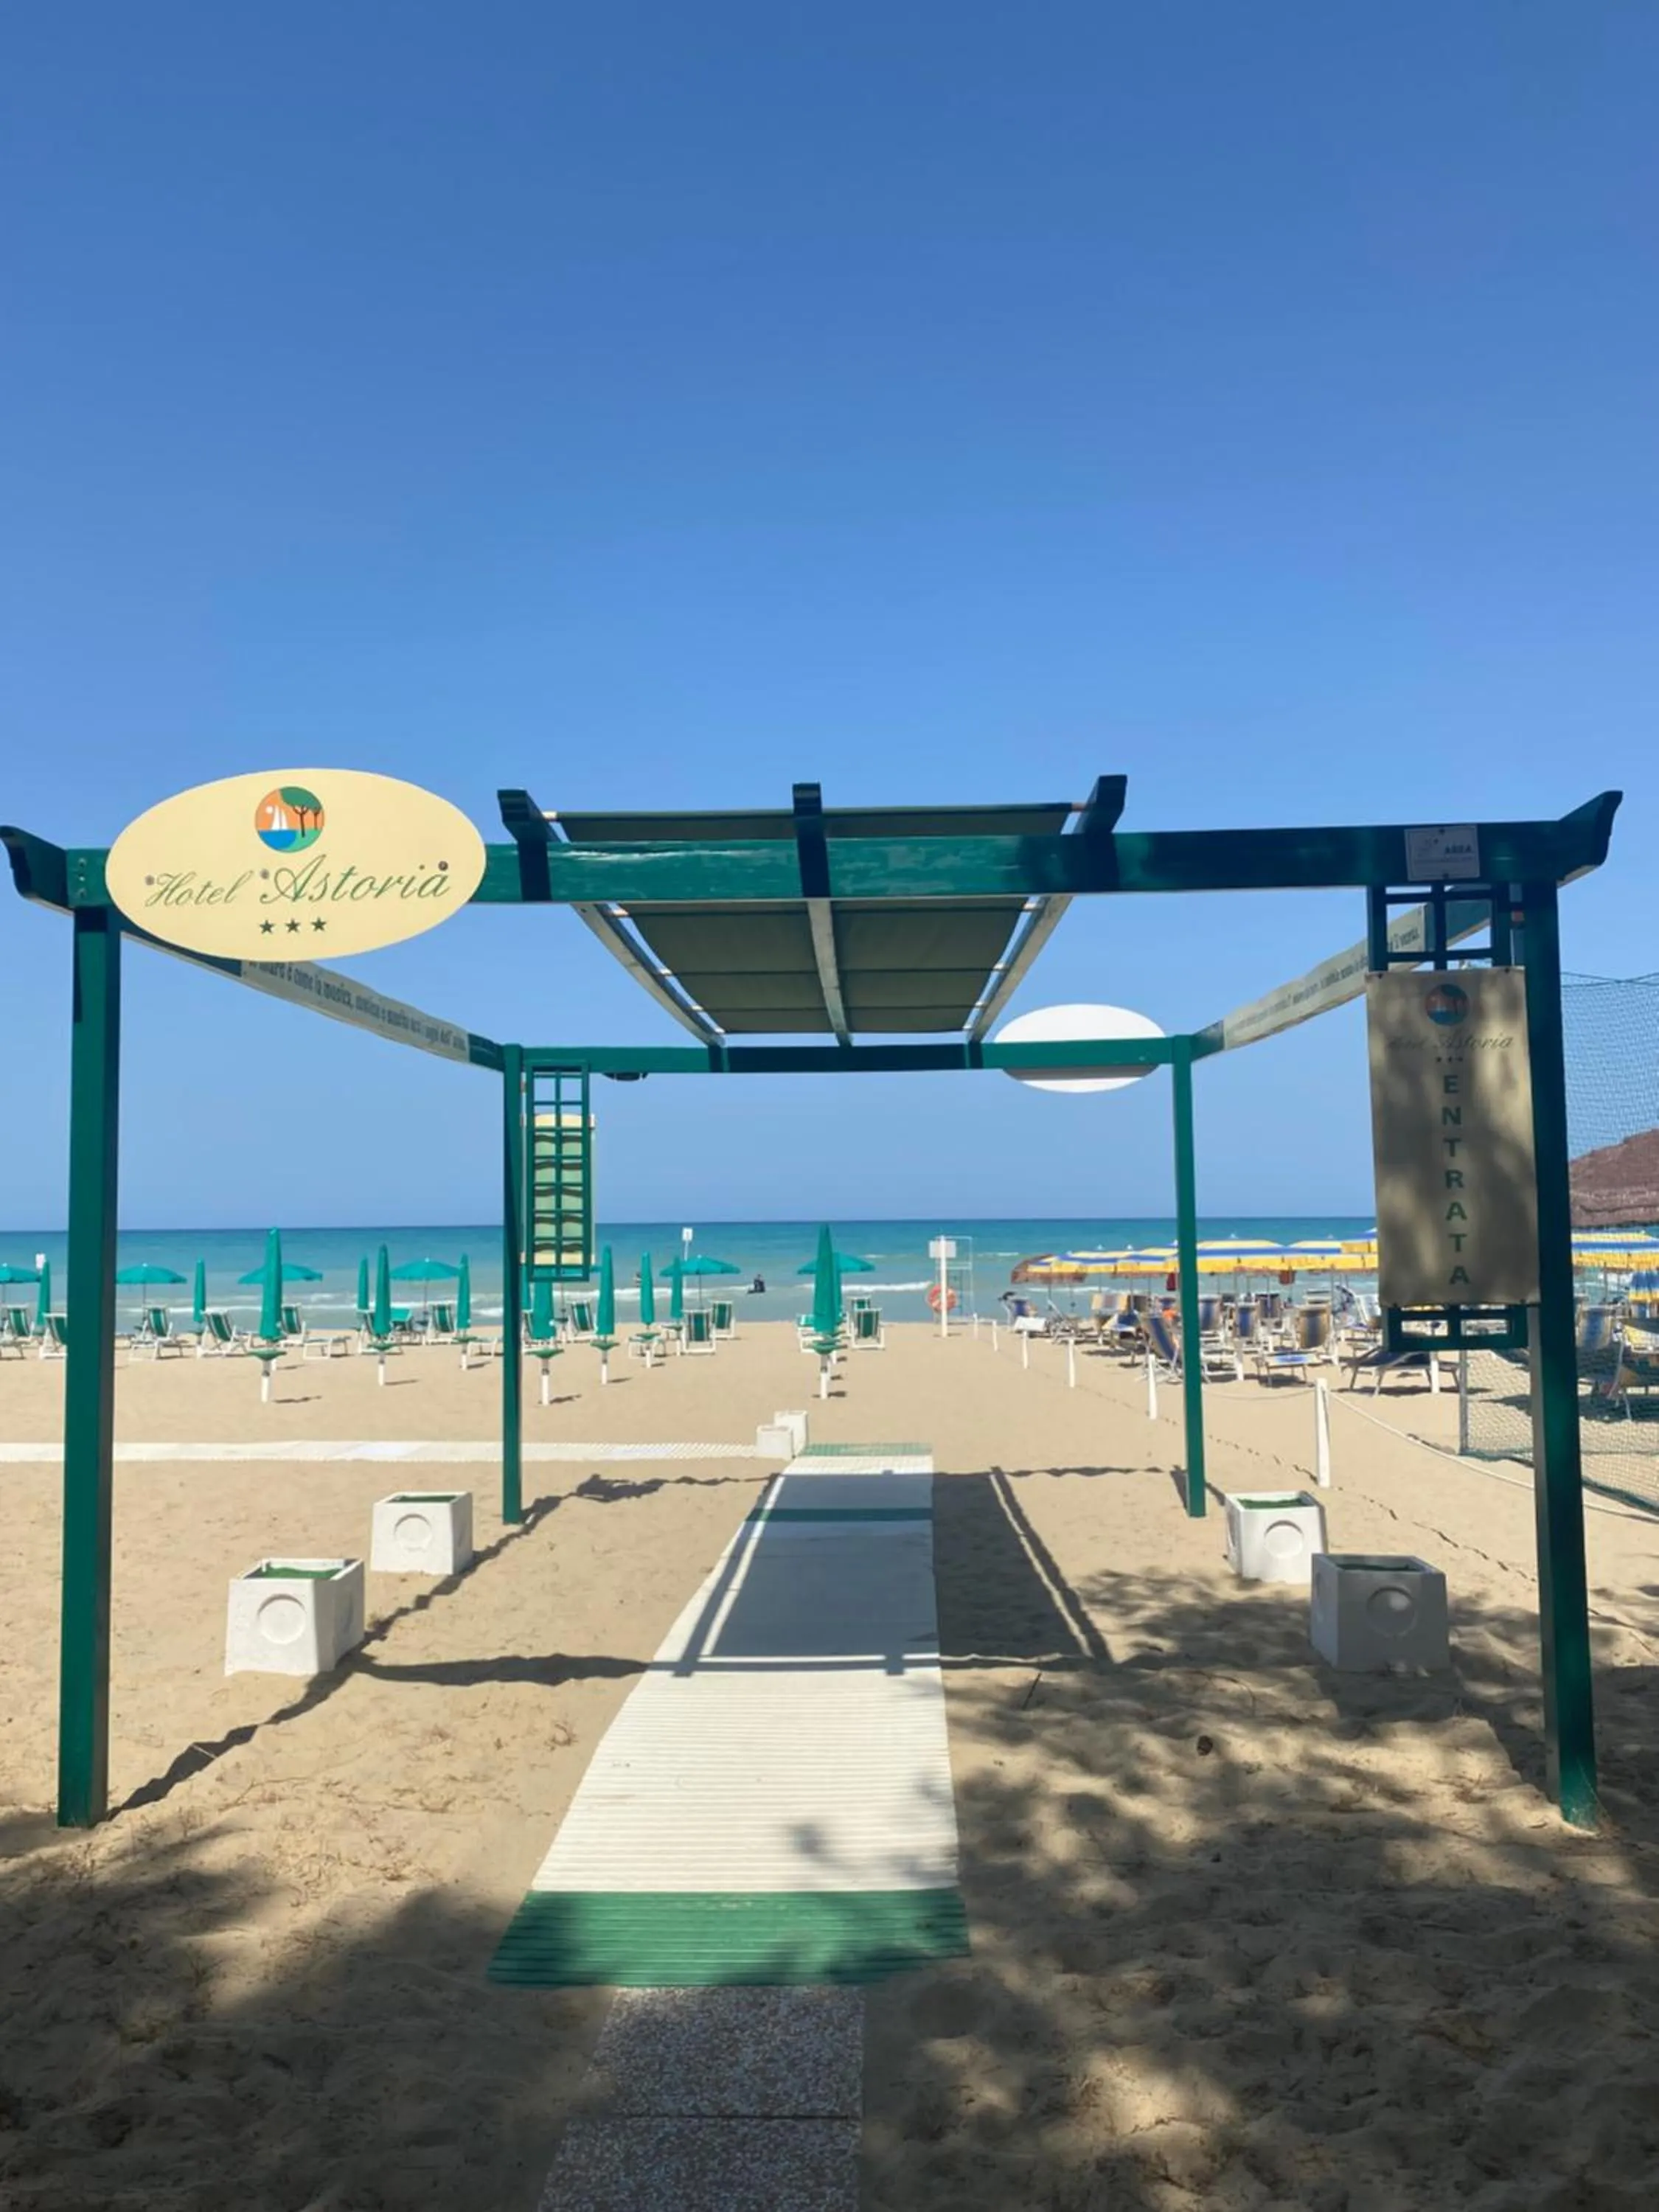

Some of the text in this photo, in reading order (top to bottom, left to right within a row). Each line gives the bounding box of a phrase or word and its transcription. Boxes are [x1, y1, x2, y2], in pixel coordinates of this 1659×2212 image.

[145, 854, 451, 908] Hotel Astoria
[1440, 1074, 1470, 1286] ENTRATA
